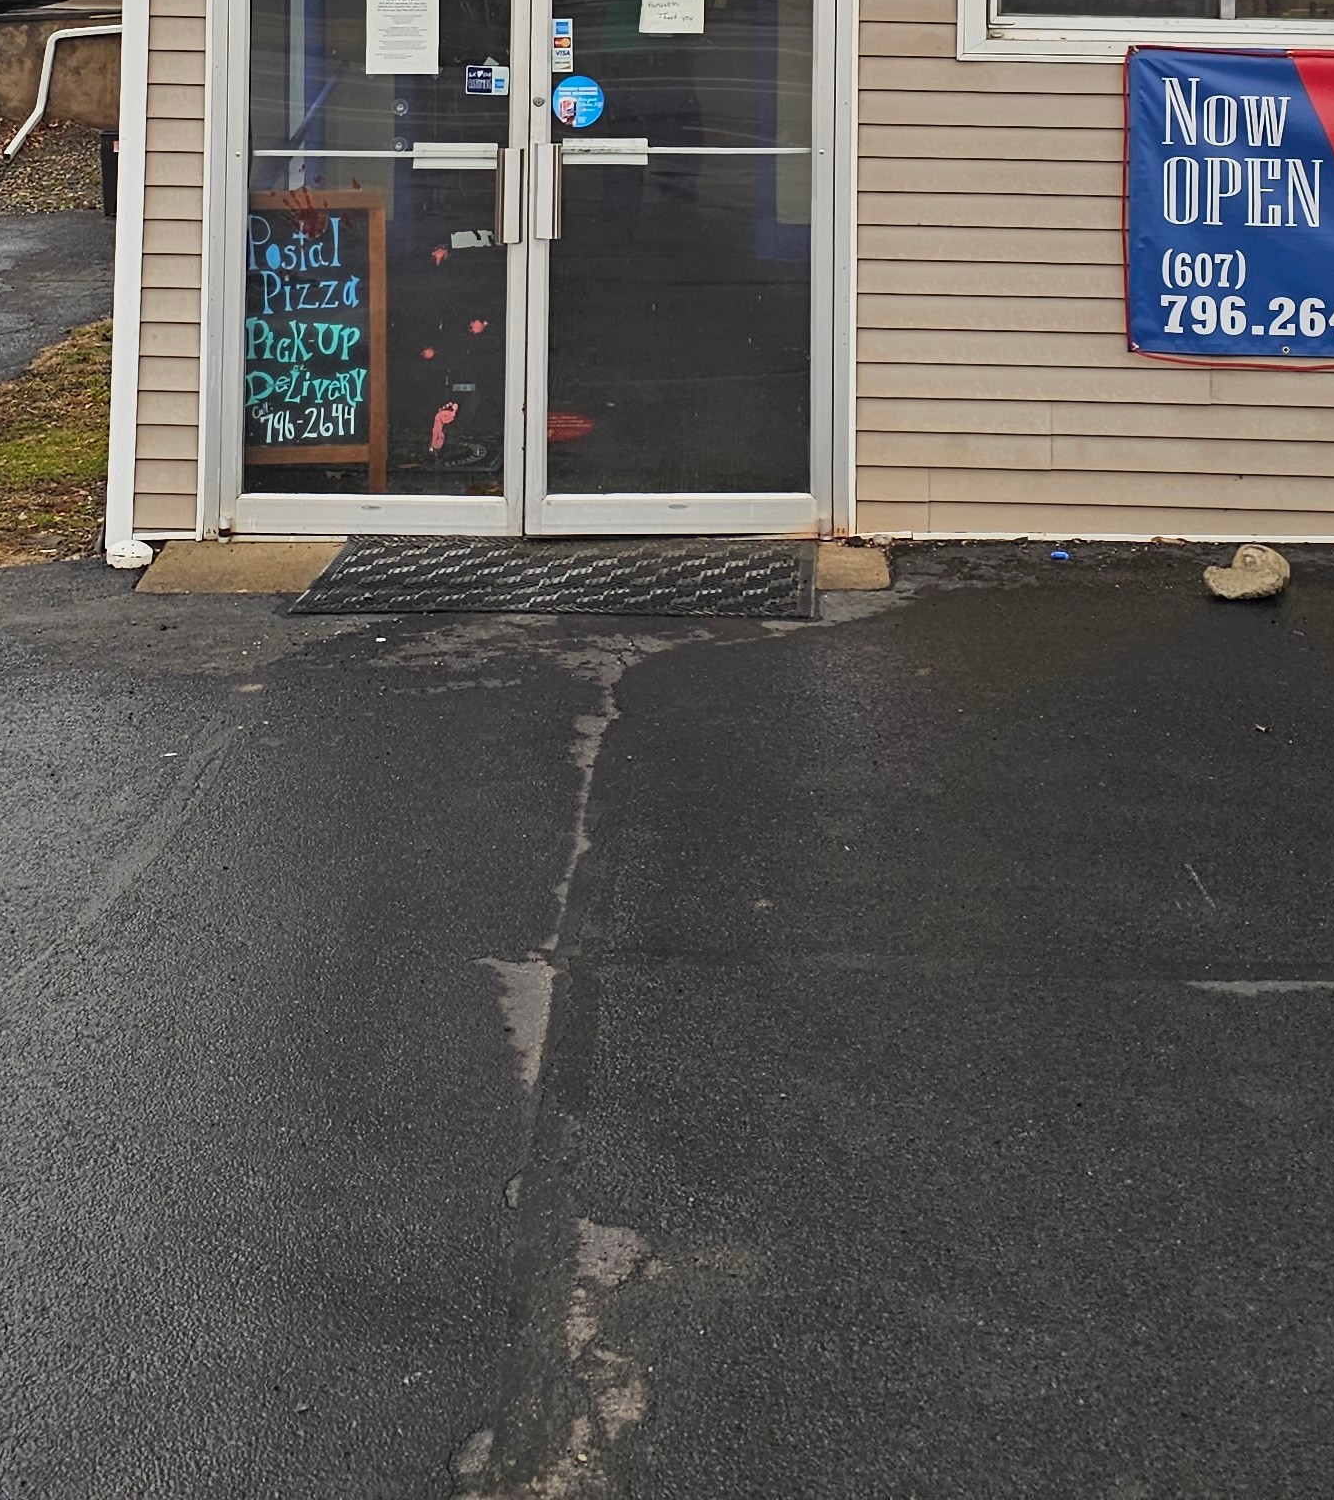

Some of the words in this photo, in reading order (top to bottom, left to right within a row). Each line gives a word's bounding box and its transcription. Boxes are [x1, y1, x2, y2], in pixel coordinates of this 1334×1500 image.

[1163, 156, 1323, 228] OPEN
[247, 213, 341, 271] Postal
[1161, 248, 1247, 290] (607)
[261, 270, 360, 315] Pizza
[260, 403, 355, 443] 796-2644
